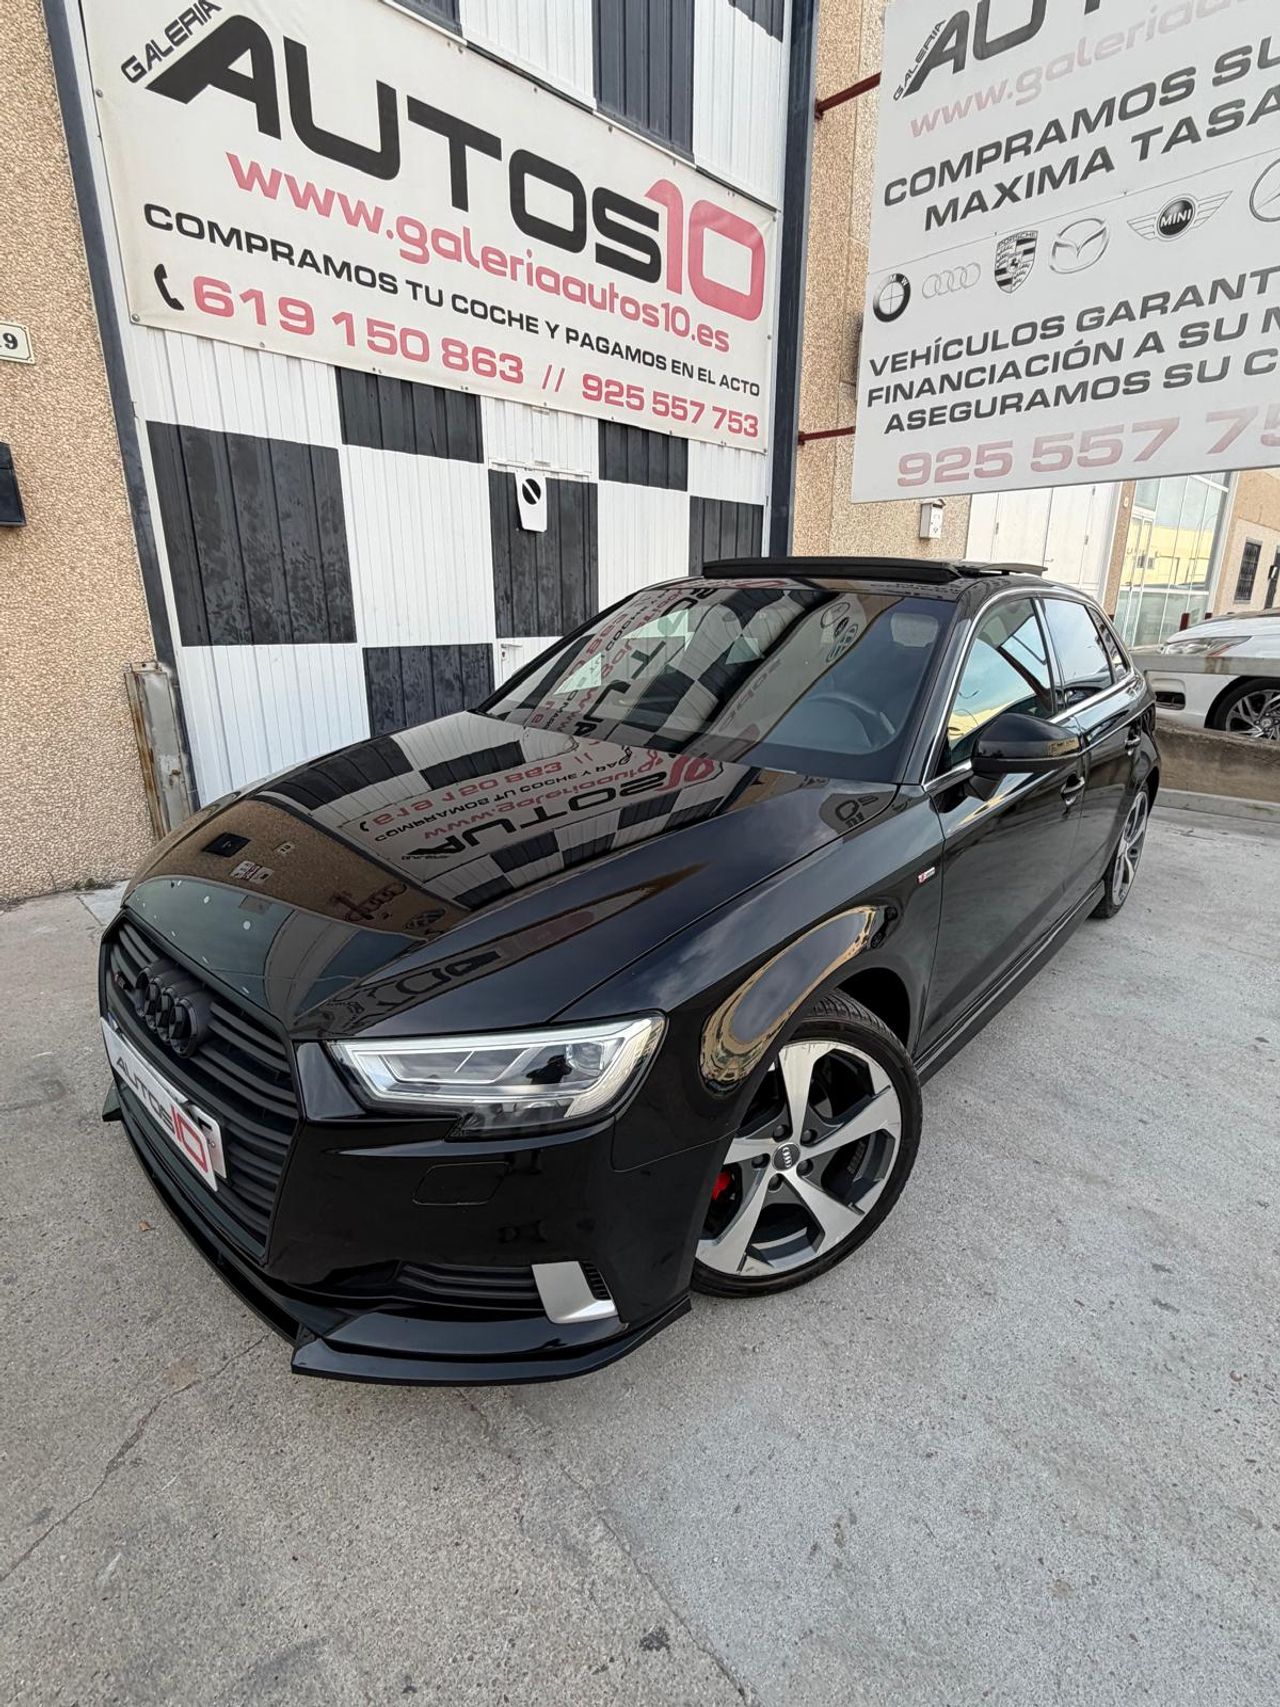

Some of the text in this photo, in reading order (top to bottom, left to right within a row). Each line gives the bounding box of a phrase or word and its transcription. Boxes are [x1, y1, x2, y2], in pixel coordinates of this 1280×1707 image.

[121, 0, 222, 84] GALERIA
[893, 19, 946, 101] GALERIA
[902, 0, 1100, 98] AU
[884, 66, 1196, 206] COMPRAMOS
[925, 147, 1115, 231] MAXIMA
[1160, 208, 1193, 228] MINI
[226, 152, 730, 352] www.galeriaautos10.es
[0, 333, 18, 350] 9
[144, 203, 760, 397] COMPRAMOS TU COCHE Y PAGAMOS EN EL ACTO
[869, 315, 1065, 376] VEHÍCULOS
[1076, 265, 1280, 333] GARANT
[193, 275, 315, 336] 619
[331, 311, 430, 363] 150
[441, 336, 524, 384] 863
[582, 372, 645, 412] 925
[652, 392, 705, 425] 557
[711, 405, 759, 438] 753
[867, 338, 1125, 407] FINANCIACIÓN
[1134, 331, 1165, 358] A
[1178, 312, 1249, 349] SU
[884, 370, 1150, 434] ASEGURAMOS
[1163, 355, 1231, 388] SU
[897, 440, 1013, 487] 925
[1030, 417, 1180, 472] 557
[116, 1056, 209, 1173] AUTOS10
